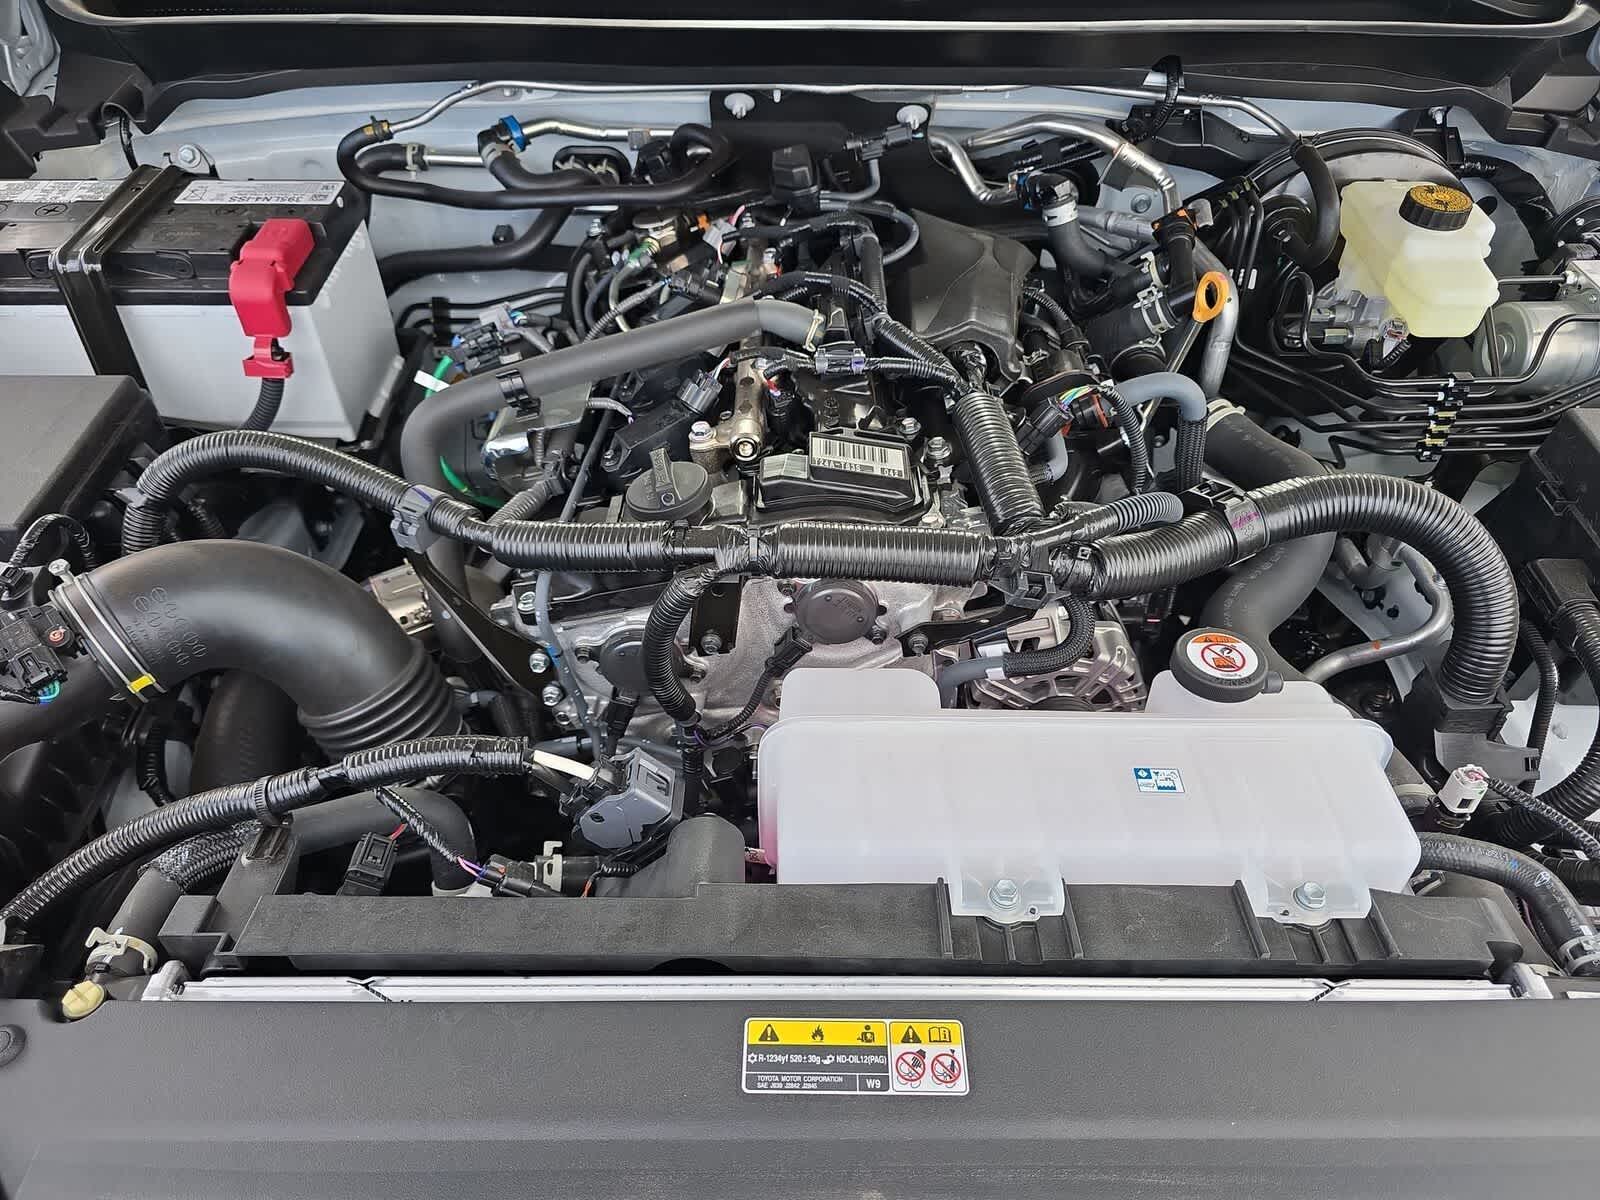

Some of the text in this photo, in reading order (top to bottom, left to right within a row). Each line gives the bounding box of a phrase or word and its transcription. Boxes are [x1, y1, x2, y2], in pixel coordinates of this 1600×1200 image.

[758, 1053, 789, 1065] R-1234yf
[803, 1075, 843, 1083] CORPORATION
[866, 1078, 881, 1089] W9
